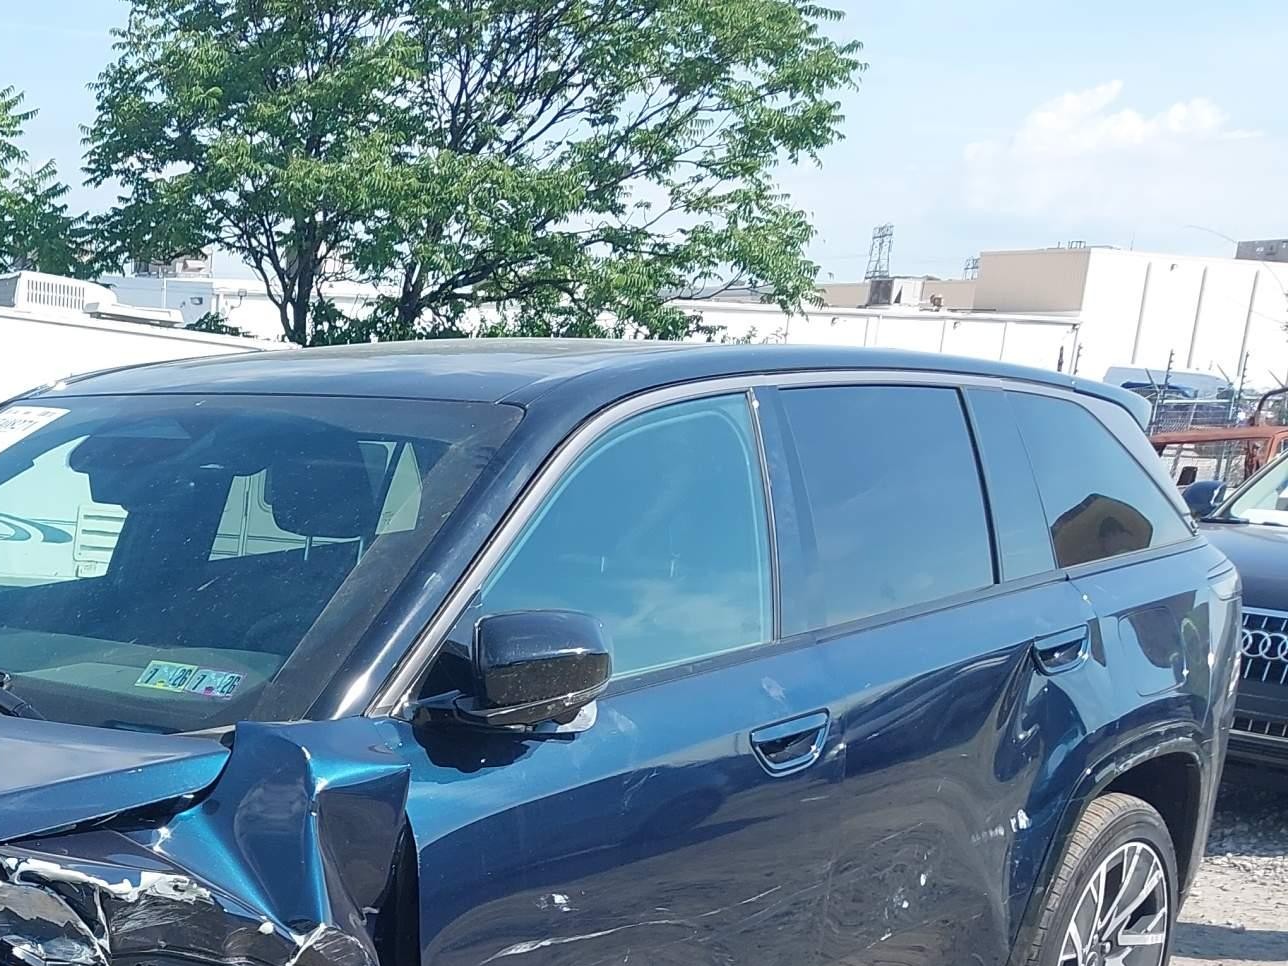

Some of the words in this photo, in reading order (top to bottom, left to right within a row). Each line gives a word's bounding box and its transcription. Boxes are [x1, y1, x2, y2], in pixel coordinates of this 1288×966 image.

[145, 667, 159, 684] 7
[171, 667, 193, 688] 26
[192, 673, 207, 690] 7
[220, 675, 240, 695] 26
